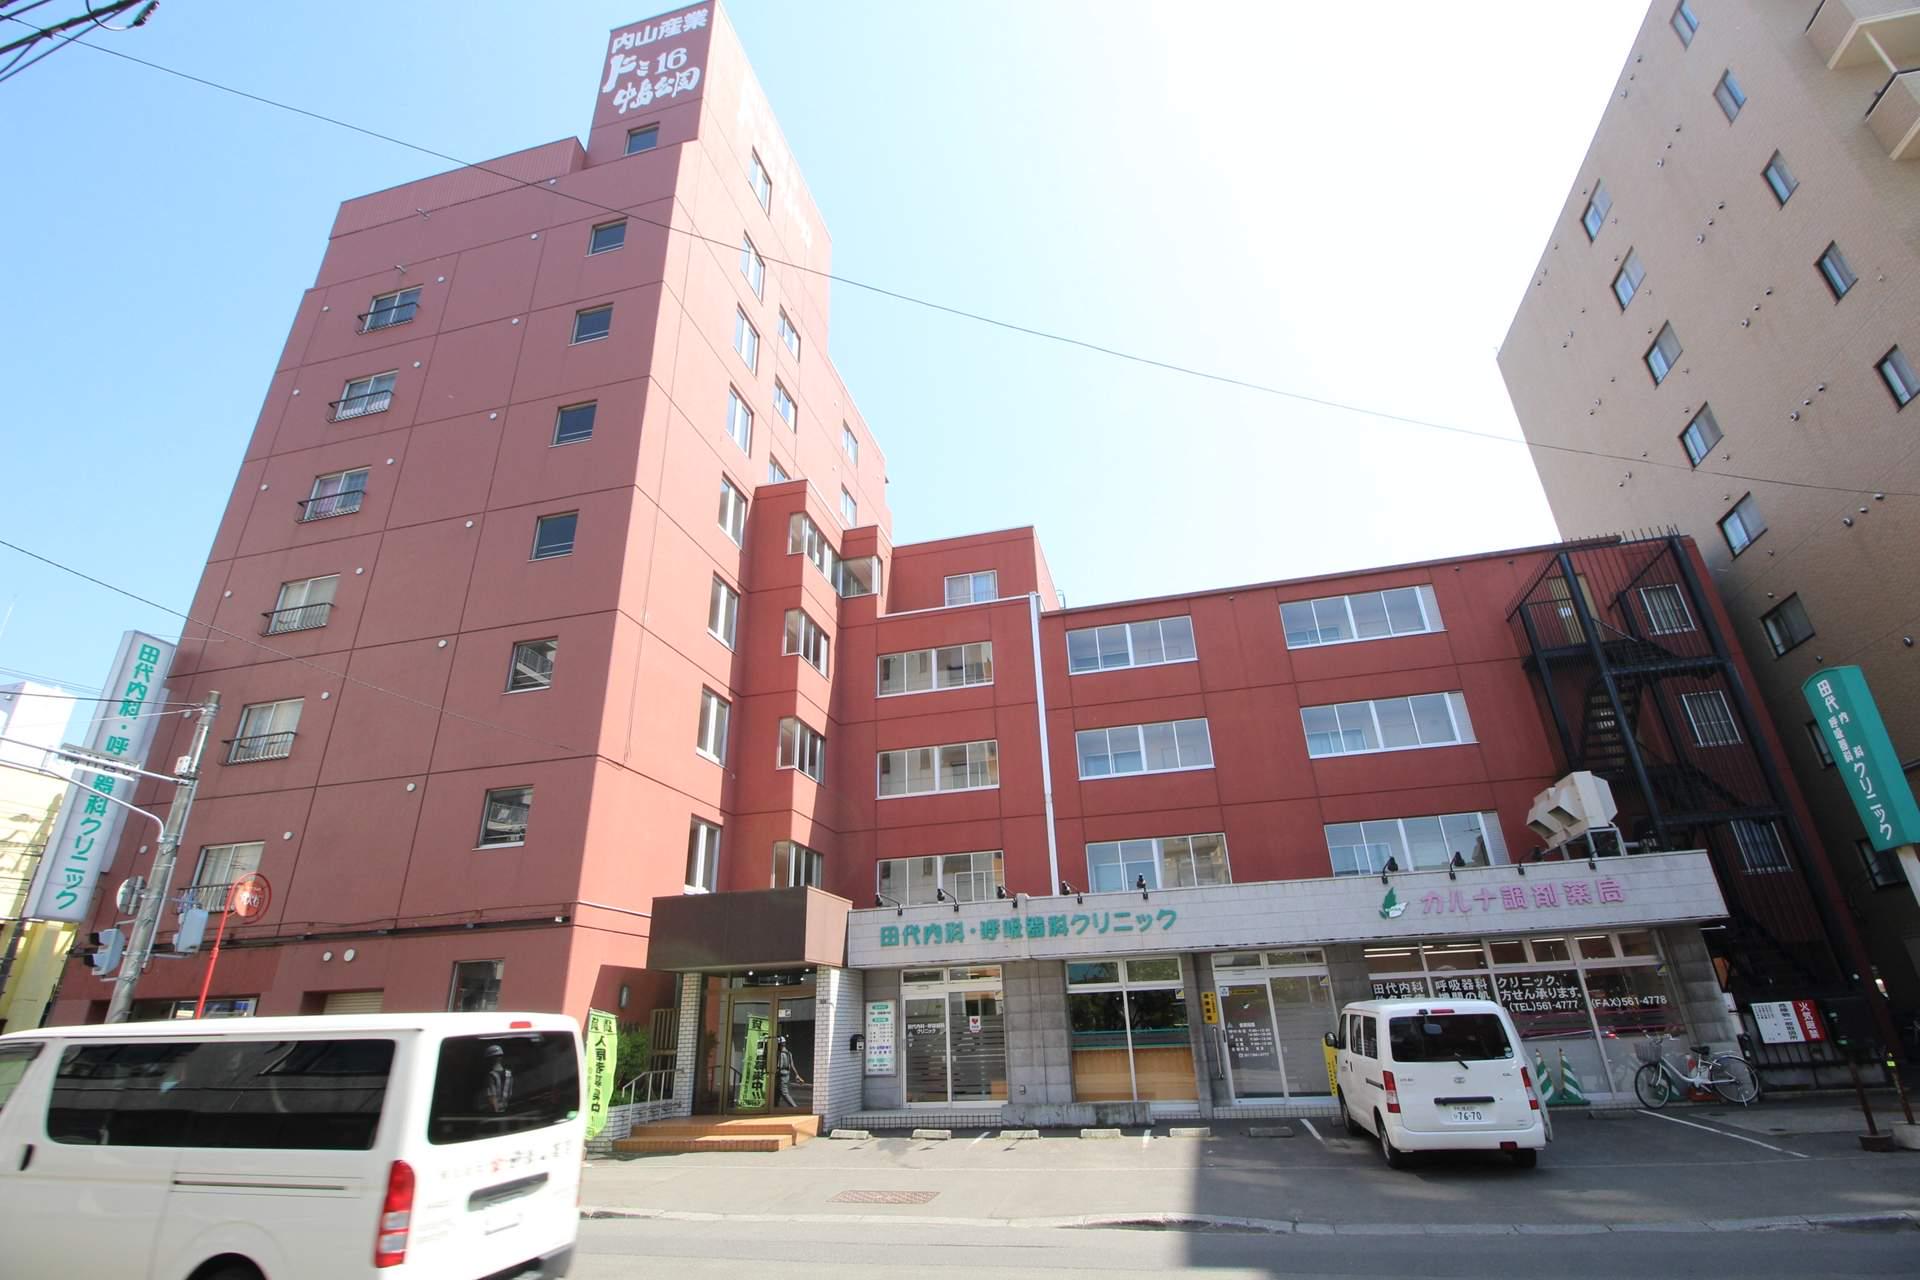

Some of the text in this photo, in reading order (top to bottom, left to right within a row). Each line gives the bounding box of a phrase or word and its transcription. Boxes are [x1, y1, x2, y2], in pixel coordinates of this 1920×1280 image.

[611, 8, 708, 53] 内山産業
[655, 48, 687, 75] 16
[56, 643, 160, 910] 田代内科・呼器科クリニック
[1421, 878, 1628, 915] カルナ調剤薬局
[880, 908, 1178, 947] 田代内科・呼吸器科クリニック
[1373, 981, 1424, 994] 田代内科
[1435, 978, 1489, 992] 呼吸器科
